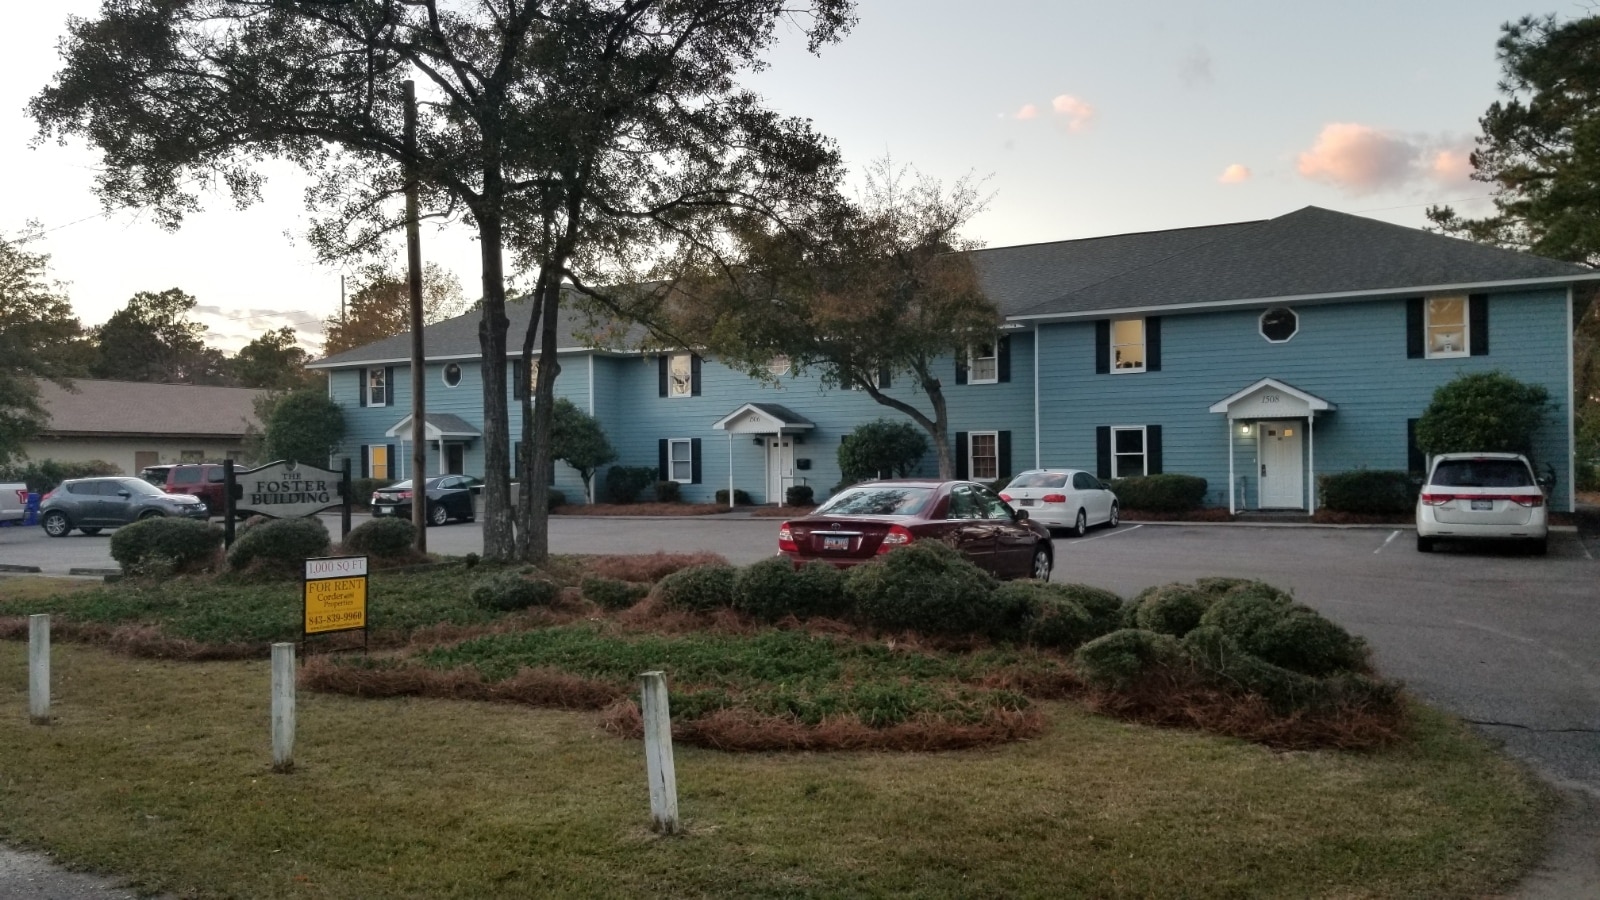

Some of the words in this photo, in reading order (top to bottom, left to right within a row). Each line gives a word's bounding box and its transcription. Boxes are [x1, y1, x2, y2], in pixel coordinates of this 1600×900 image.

[1261, 395, 1280, 404] 1508
[281, 472, 302, 480] THE
[256, 480, 327, 493] FOSTER
[251, 491, 330, 505] BUILDING
[337, 560, 350, 571] SQ
[352, 559, 364, 570] FT
[308, 581, 331, 594] FOR
[334, 579, 364, 591] RENT
[317, 592, 344, 602] Corder
